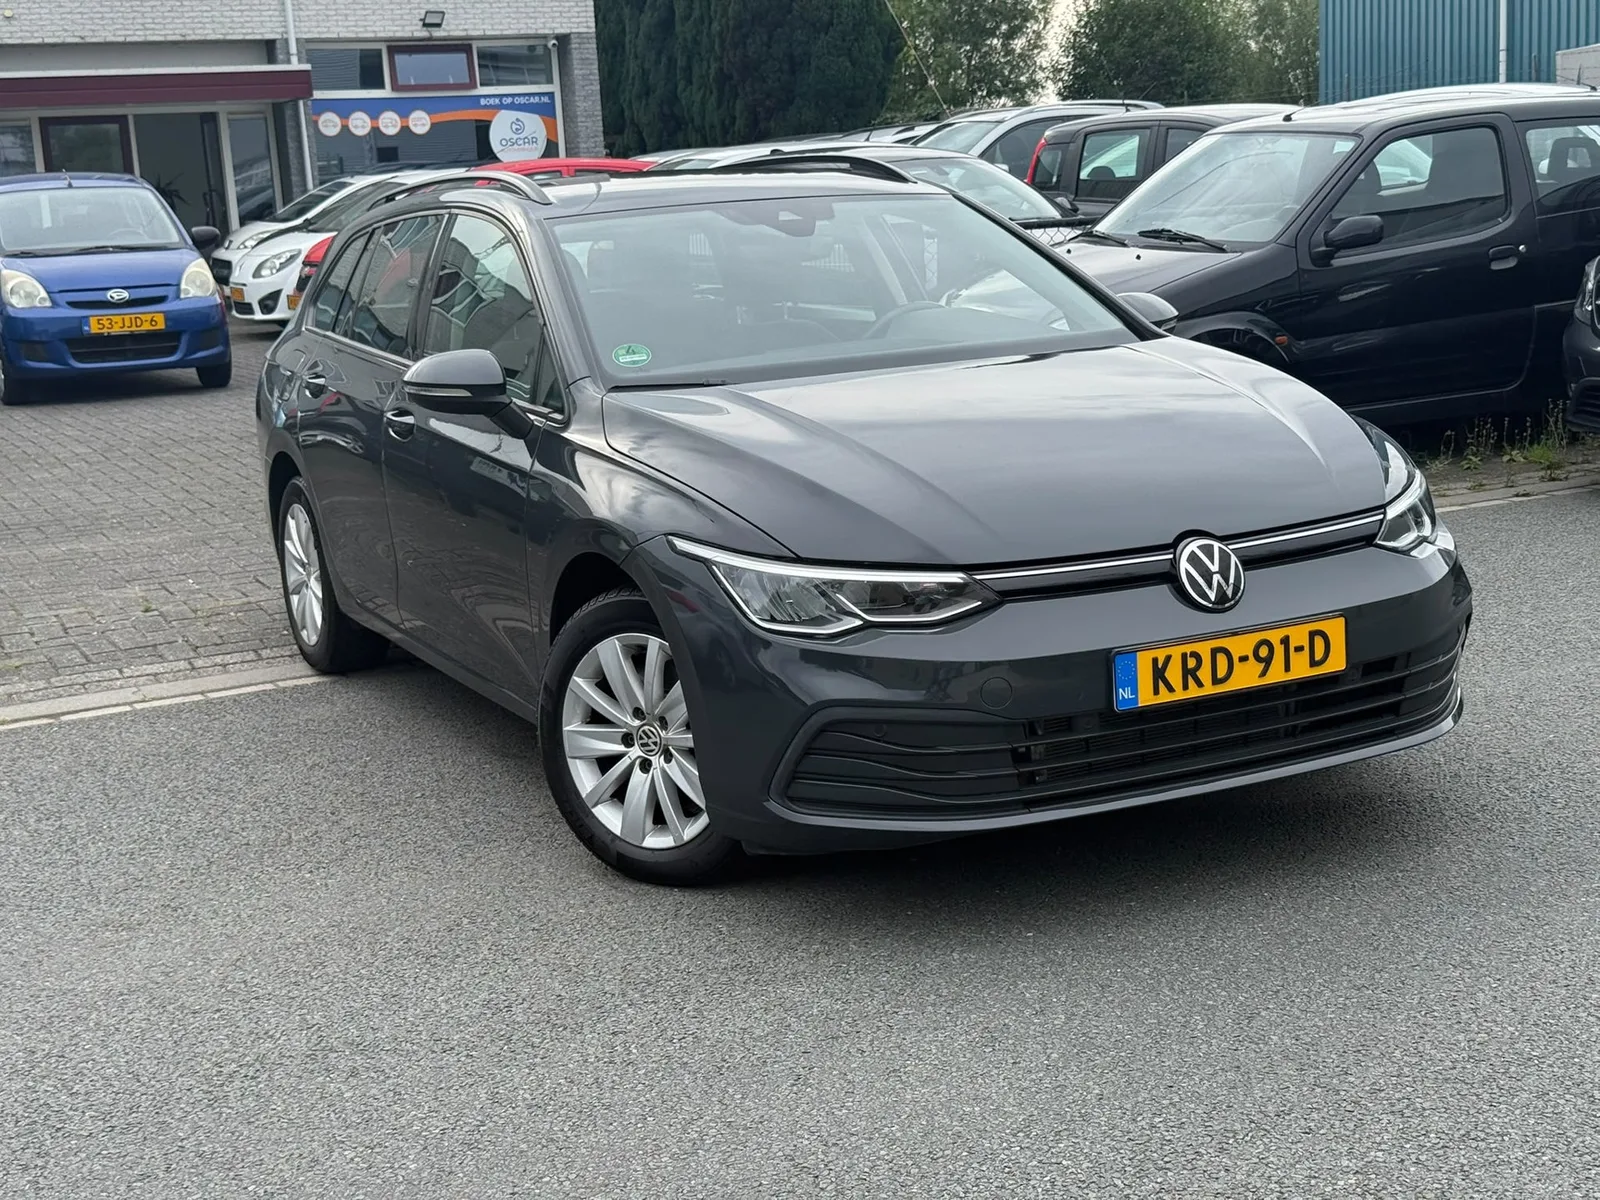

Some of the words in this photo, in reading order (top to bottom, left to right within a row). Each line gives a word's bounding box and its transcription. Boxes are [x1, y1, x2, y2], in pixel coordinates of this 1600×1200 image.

[480, 97, 500, 106] BOEK
[502, 97, 513, 105] OP
[514, 95, 551, 104] OSCAR.NL
[499, 136, 539, 147] OSCAR
[97, 315, 158, 330] 53-JJD-6
[1180, 538, 1244, 608] VW
[1151, 628, 1331, 696] KRD-91-D
[1118, 686, 1136, 699] NL
